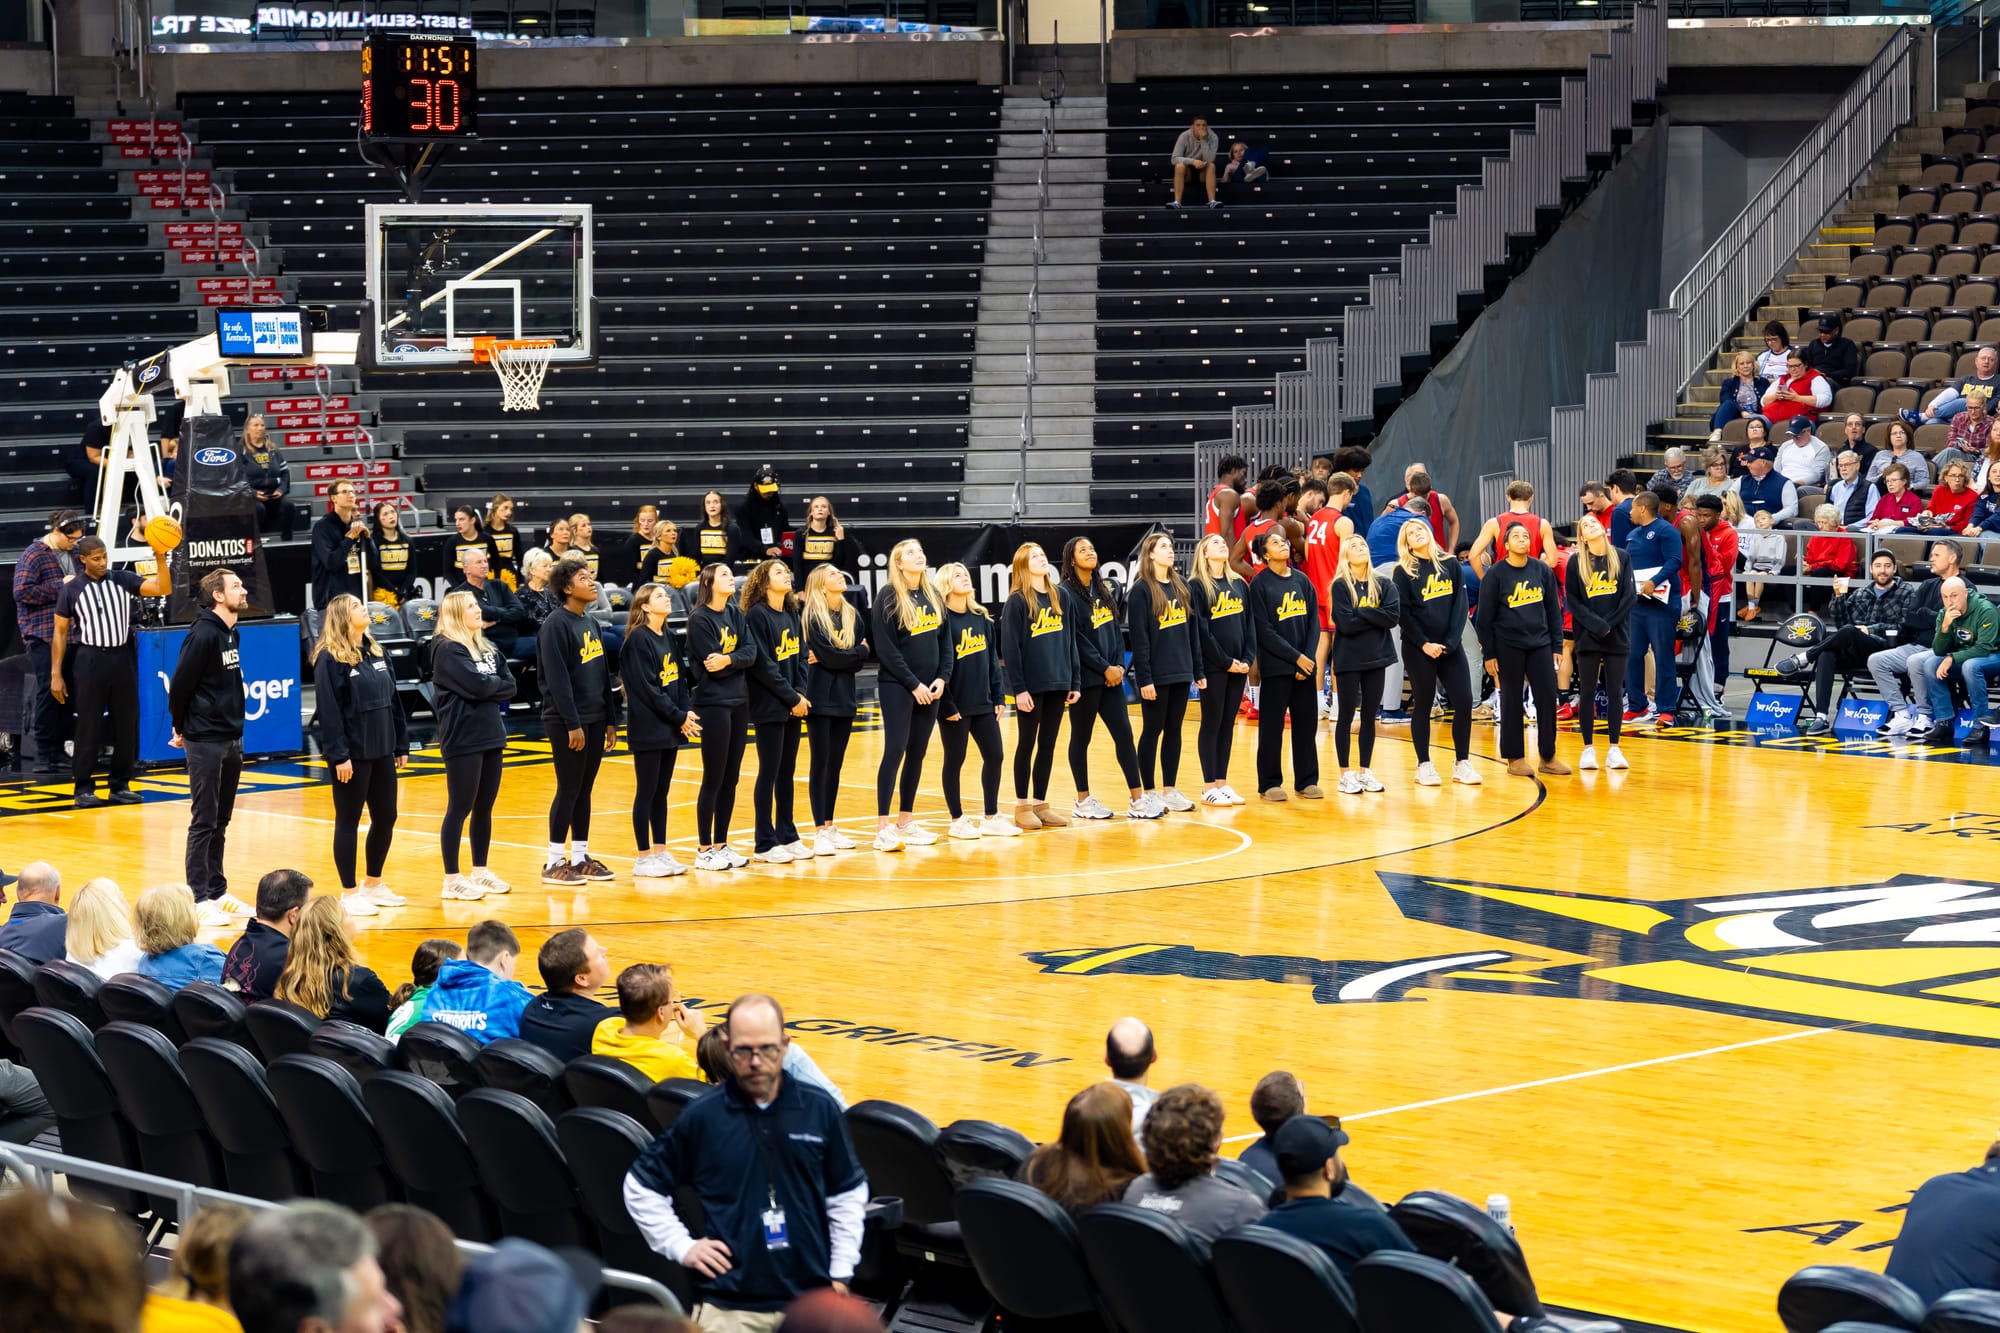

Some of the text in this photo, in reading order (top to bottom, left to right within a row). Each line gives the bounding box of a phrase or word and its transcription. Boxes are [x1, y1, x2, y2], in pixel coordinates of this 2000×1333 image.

[405, 45, 470, 75] 11:51
[410, 79, 459, 131] 30
[223, 322, 230, 332] Be
[254, 321, 275, 333] BUCKLE
[280, 321, 298, 332] PHONE
[225, 333, 252, 345] Kentucky.
[269, 334, 276, 344] UP
[281, 334, 298, 345] DOWN
[202, 450, 228, 462] Ford
[1308, 519, 1328, 546] 24
[188, 539, 246, 558] DONATOS
[227, 556, 255, 564] important.
[242, 678, 294, 720] ger
[1765, 700, 1793, 718] Kroger
[1853, 706, 1882, 725] Kroger
[783, 1018, 1074, 1069] GRIFFIN
